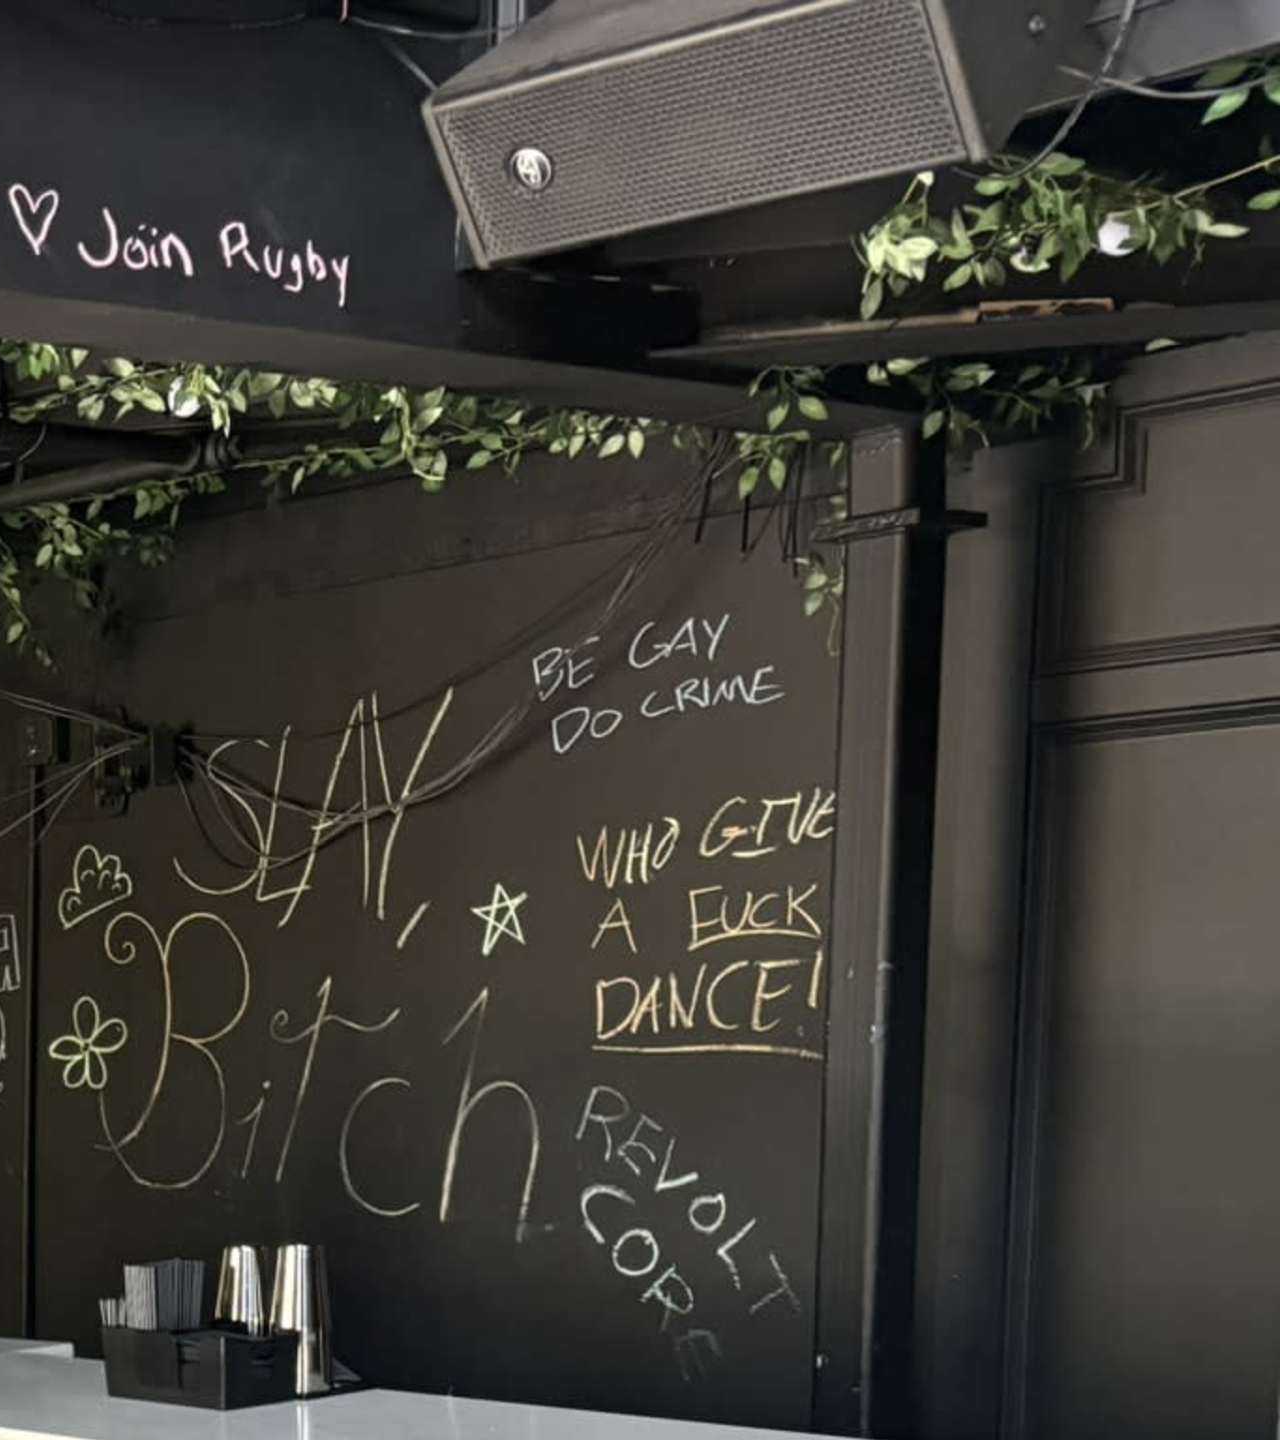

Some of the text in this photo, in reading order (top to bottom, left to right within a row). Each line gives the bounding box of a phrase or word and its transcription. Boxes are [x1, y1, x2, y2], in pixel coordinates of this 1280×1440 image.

[77, 206, 195, 278] Join
[219, 219, 351, 307] Rugby
[532, 613, 731, 701] BE GAY
[551, 664, 786, 754] DO CRIME
[576, 786, 836, 889] WHO GIVE
[591, 883, 822, 953] A FUCK
[593, 950, 824, 1060] DANCE!
[92, 910, 542, 1243] Bitch
[574, 1084, 802, 1316] REVOLT
